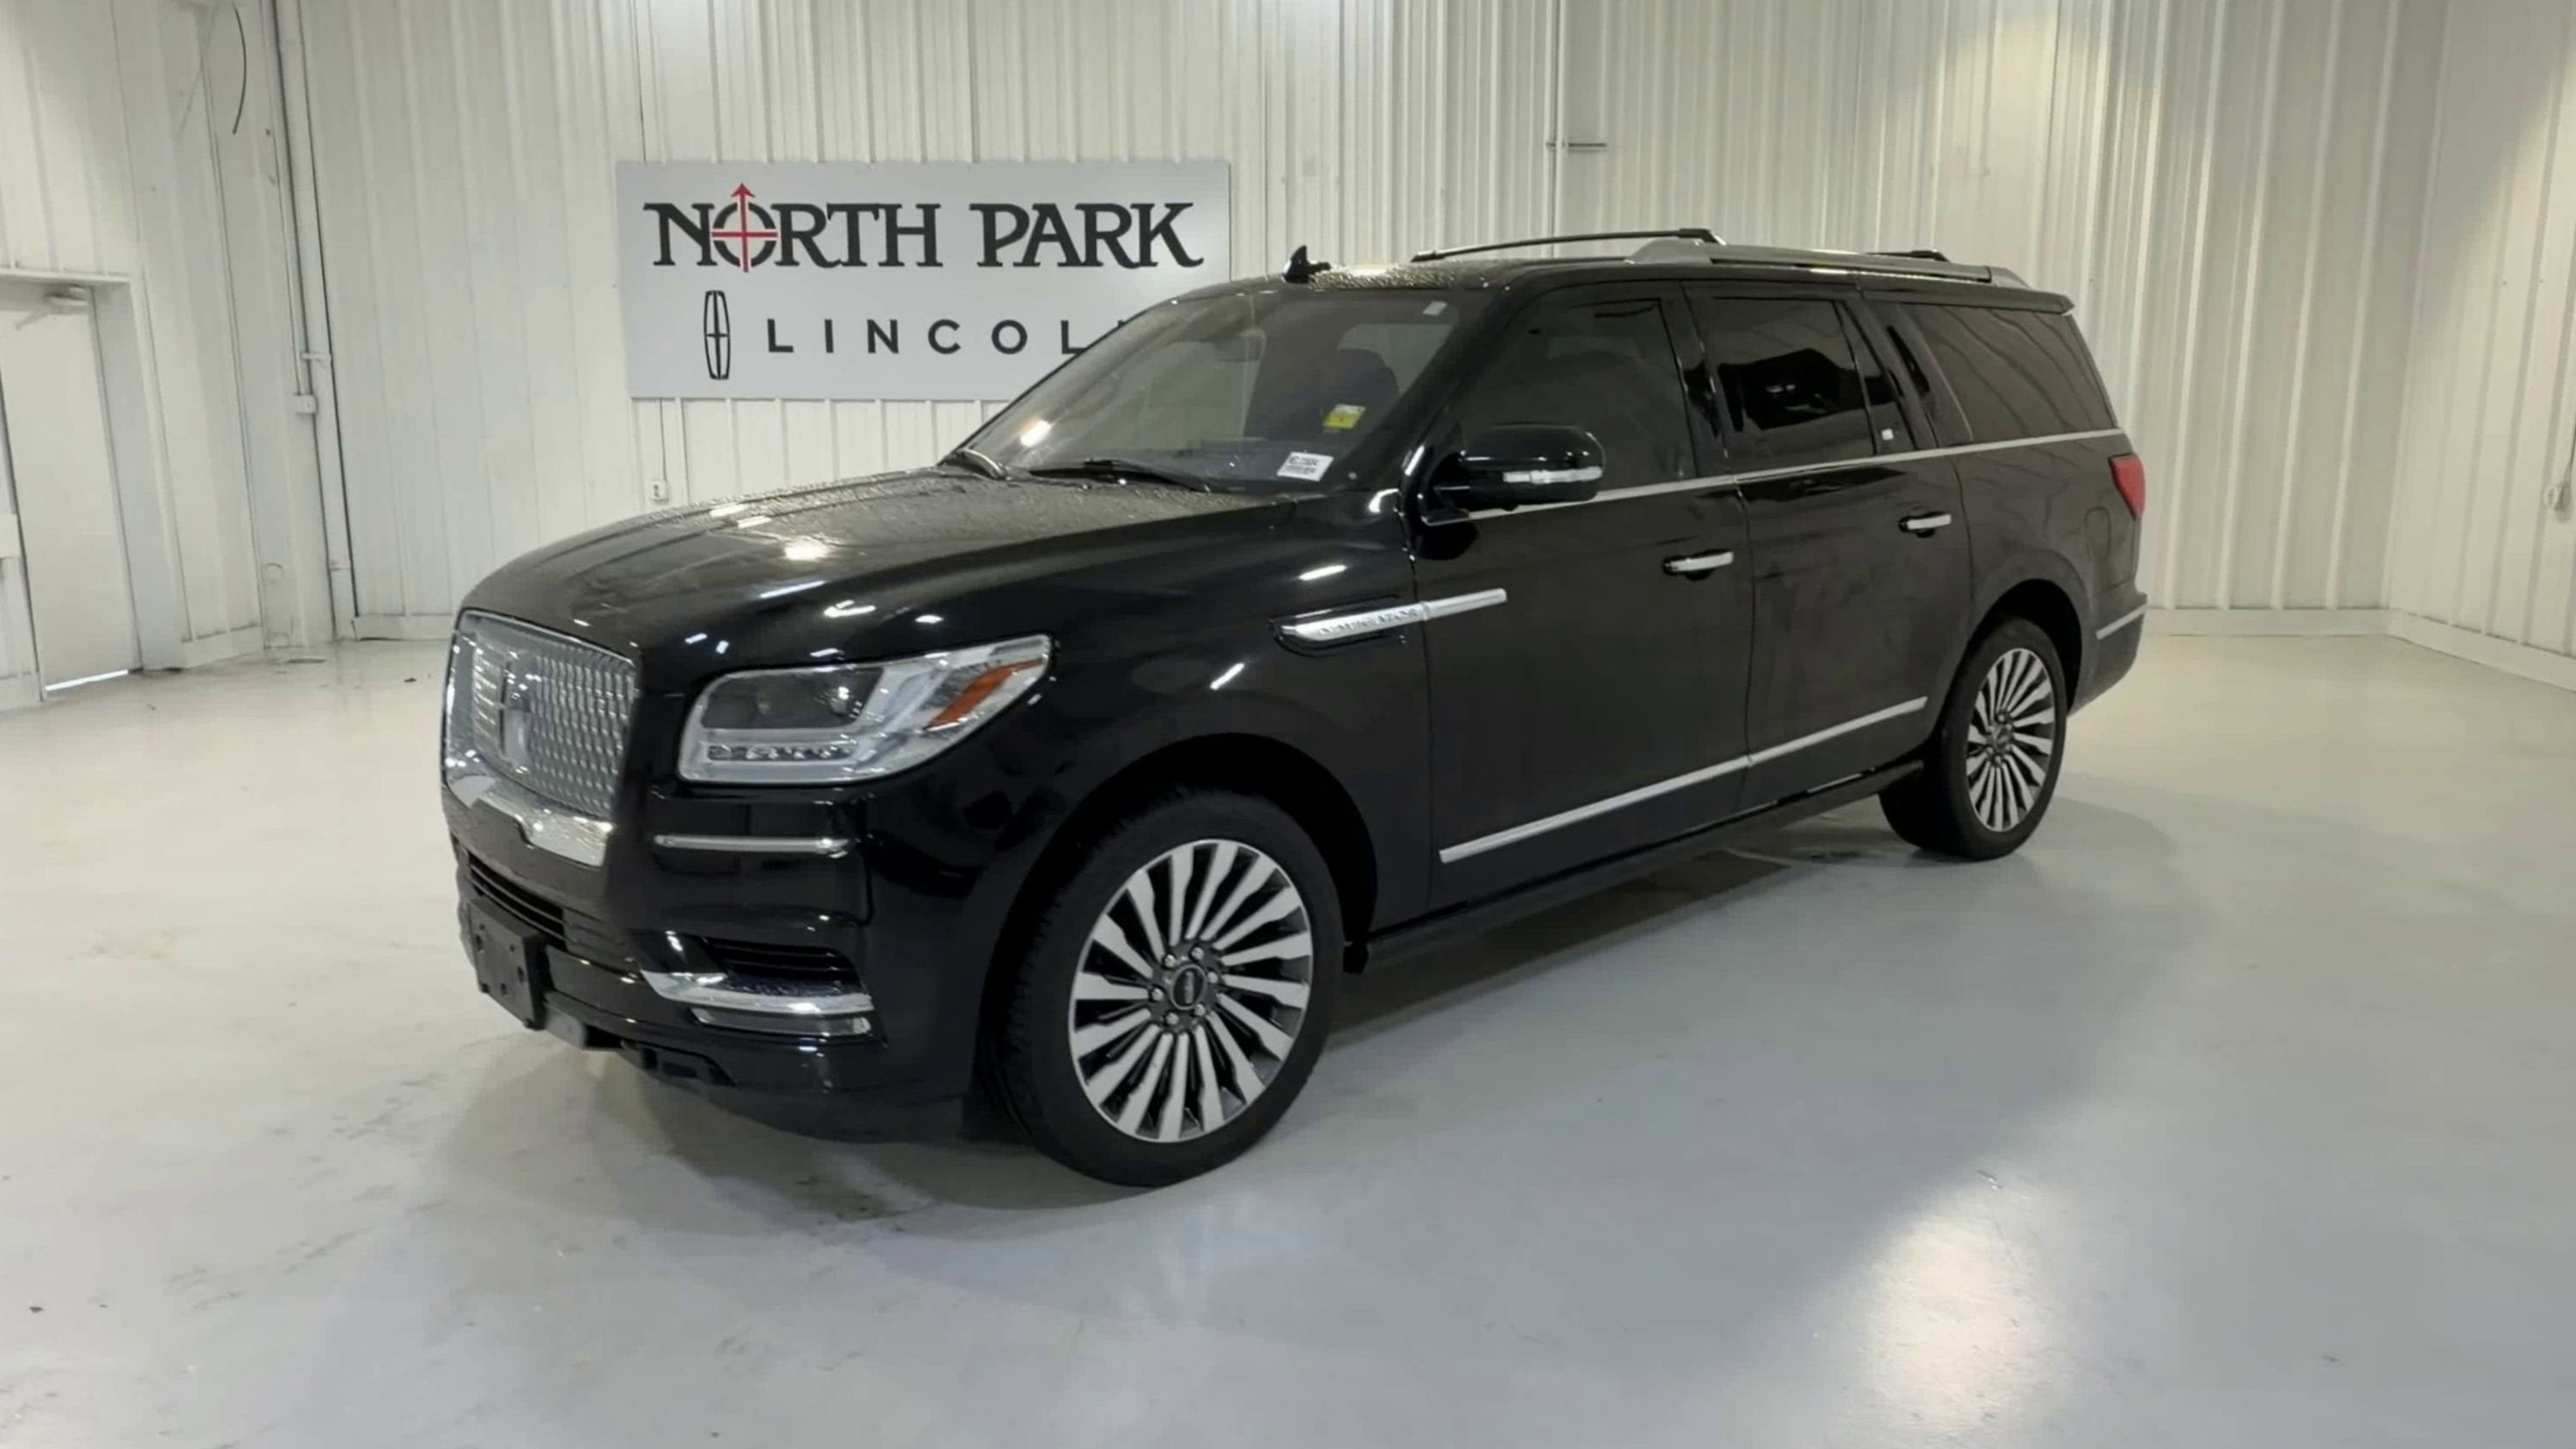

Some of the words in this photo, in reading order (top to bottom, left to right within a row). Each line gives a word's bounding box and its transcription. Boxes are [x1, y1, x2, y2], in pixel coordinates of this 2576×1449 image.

[642, 202, 943, 270] NORTH
[969, 202, 1204, 270] PARK
[767, 318, 1127, 355] LINCOL
